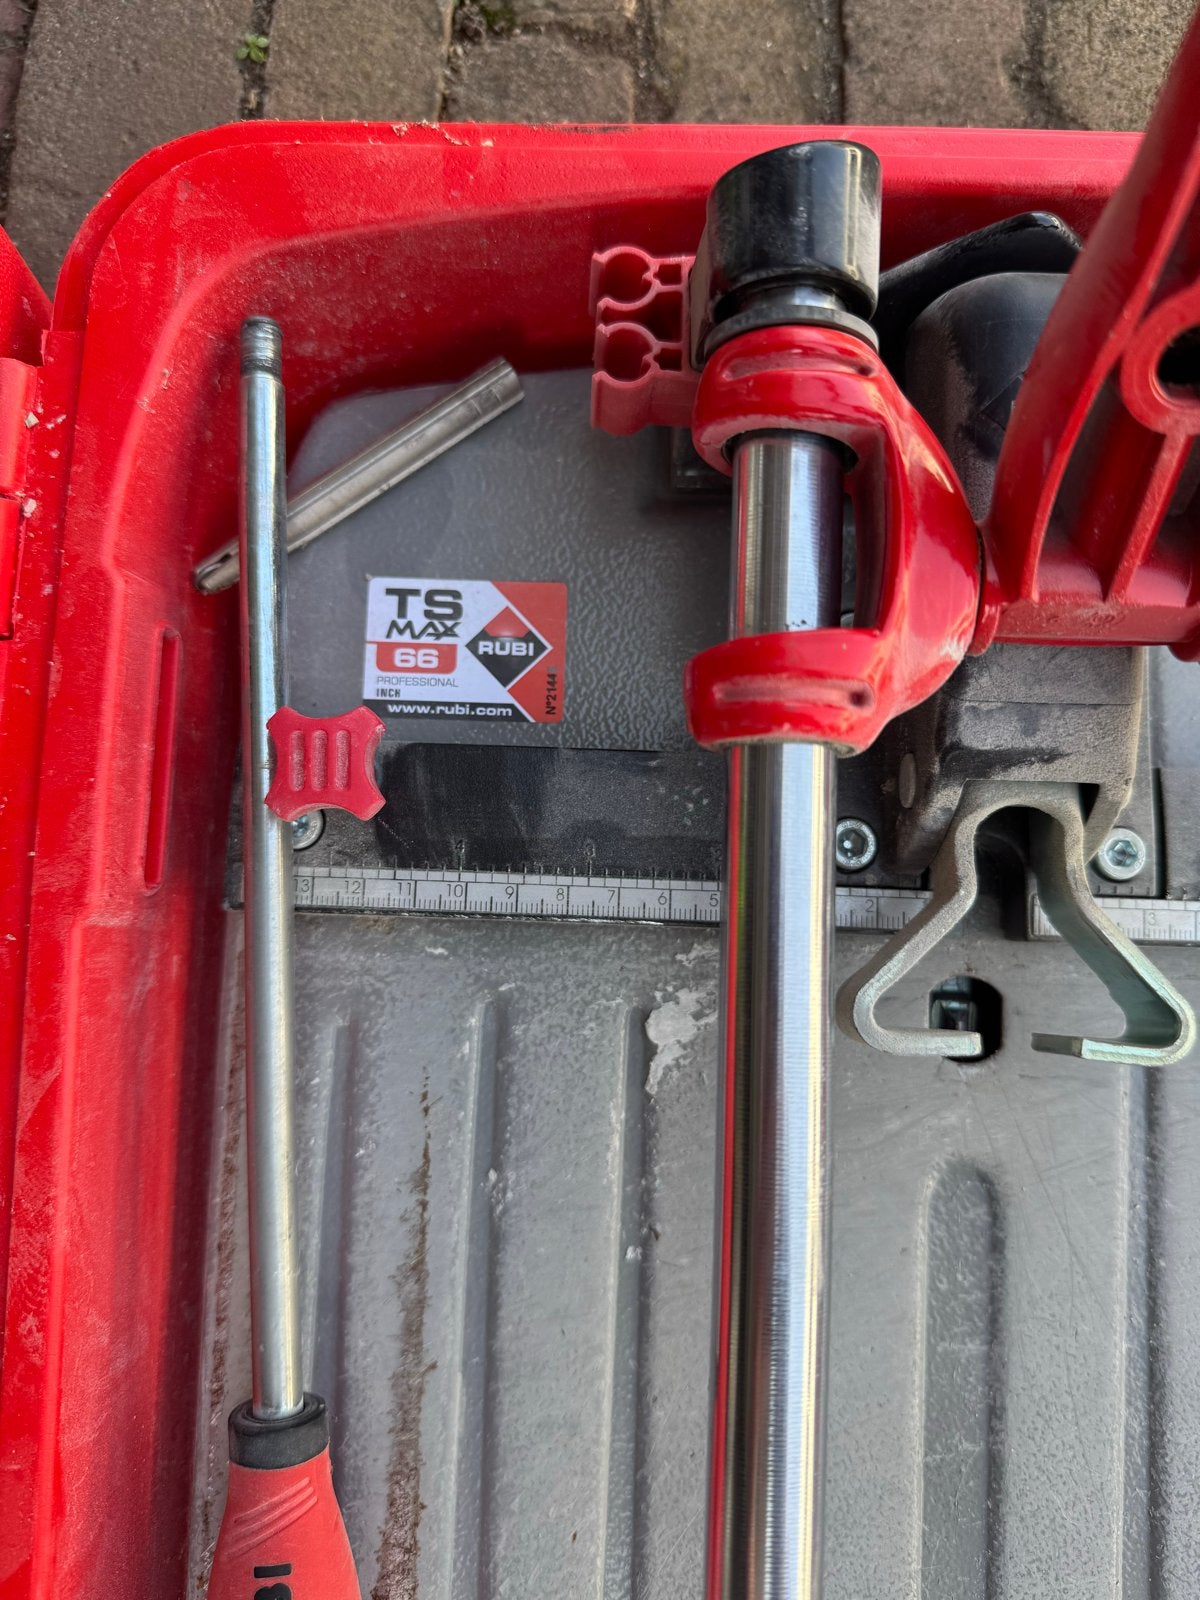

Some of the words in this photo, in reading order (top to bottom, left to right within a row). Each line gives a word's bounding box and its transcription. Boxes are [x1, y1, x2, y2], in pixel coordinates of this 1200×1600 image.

[385, 588, 463, 621] TS
[385, 620, 462, 641] MAX
[478, 641, 534, 657] RUBI
[393, 648, 440, 669] 66
[376, 676, 459, 688] PROFESSIONAL
[376, 688, 401, 698] INCH
[387, 703, 513, 718] www.rubi.com
[294, 878, 310, 893] 13
[344, 880, 361, 895] 12
[397, 882, 413, 896] 11
[447, 883, 464, 898] 10
[505, 885, 515, 899] 9
[556, 887, 565, 901] 8
[607, 889, 616, 903] 7
[657, 891, 668, 906] 6
[709, 893, 719, 907] 5
[865, 899, 875, 913] 2
[1148, 911, 1158, 926] 3
